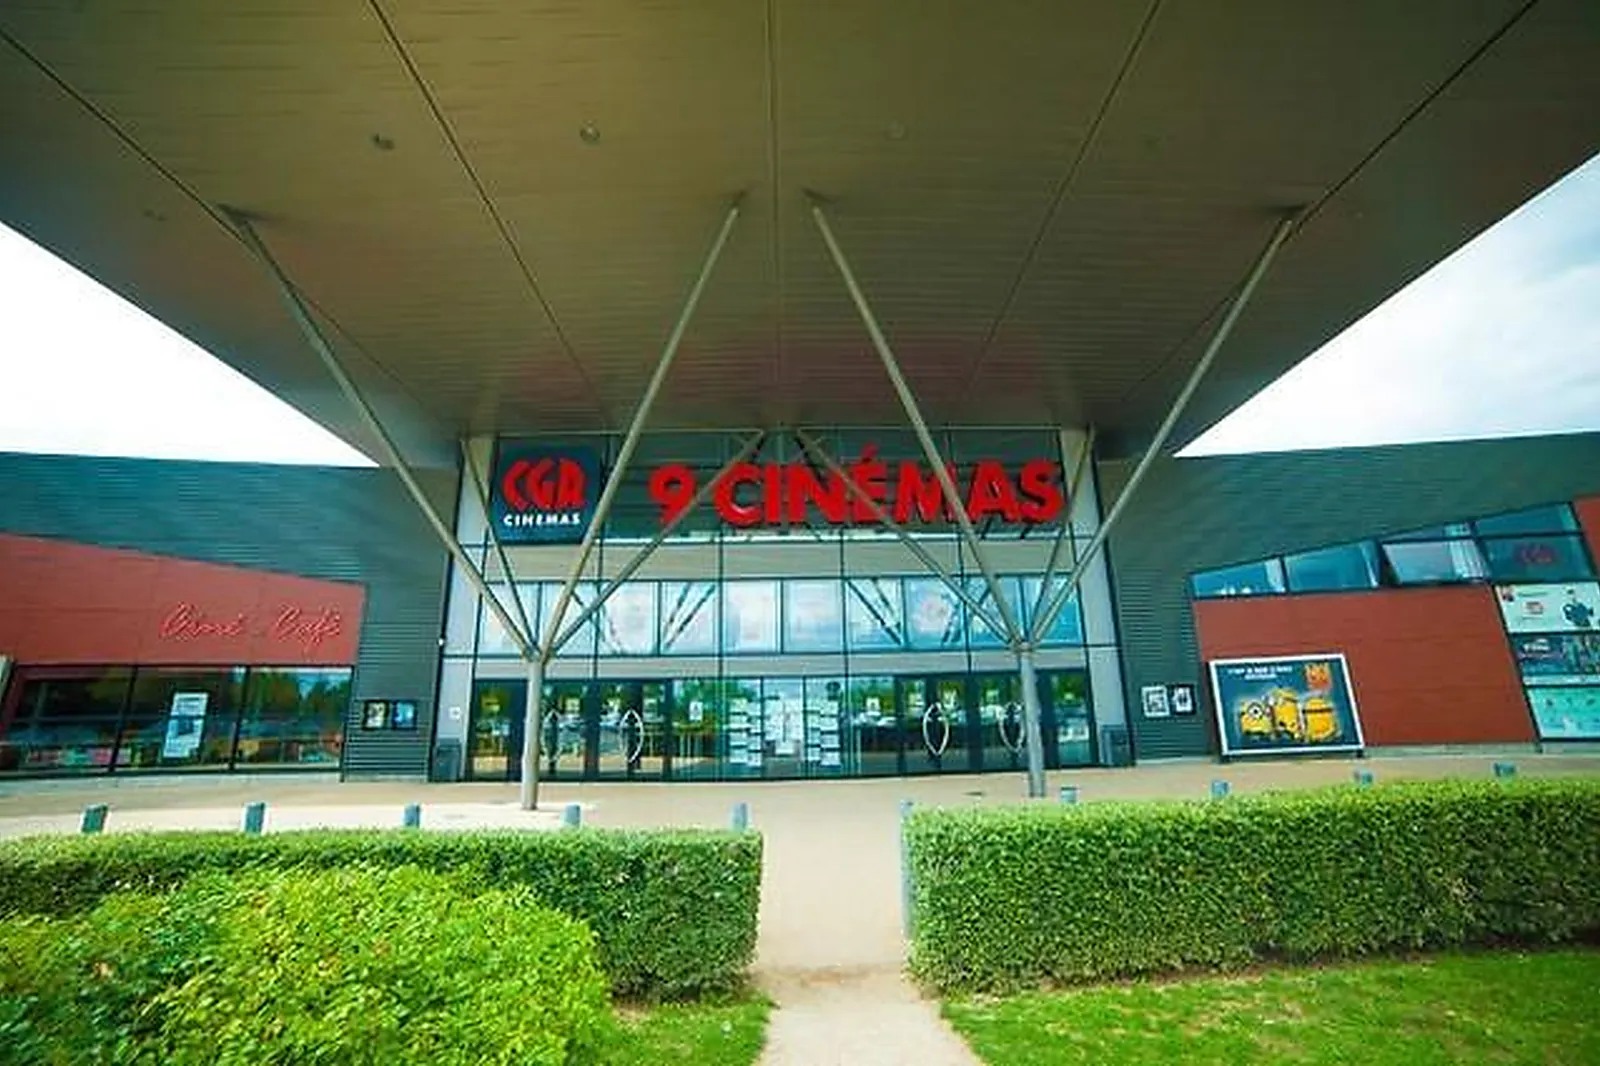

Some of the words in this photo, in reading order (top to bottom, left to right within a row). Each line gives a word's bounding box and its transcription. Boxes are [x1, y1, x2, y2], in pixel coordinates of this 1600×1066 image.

[648, 465, 696, 524] 9
[713, 444, 1064, 526] CINÉMAS
[503, 513, 581, 527] CINEMAS
